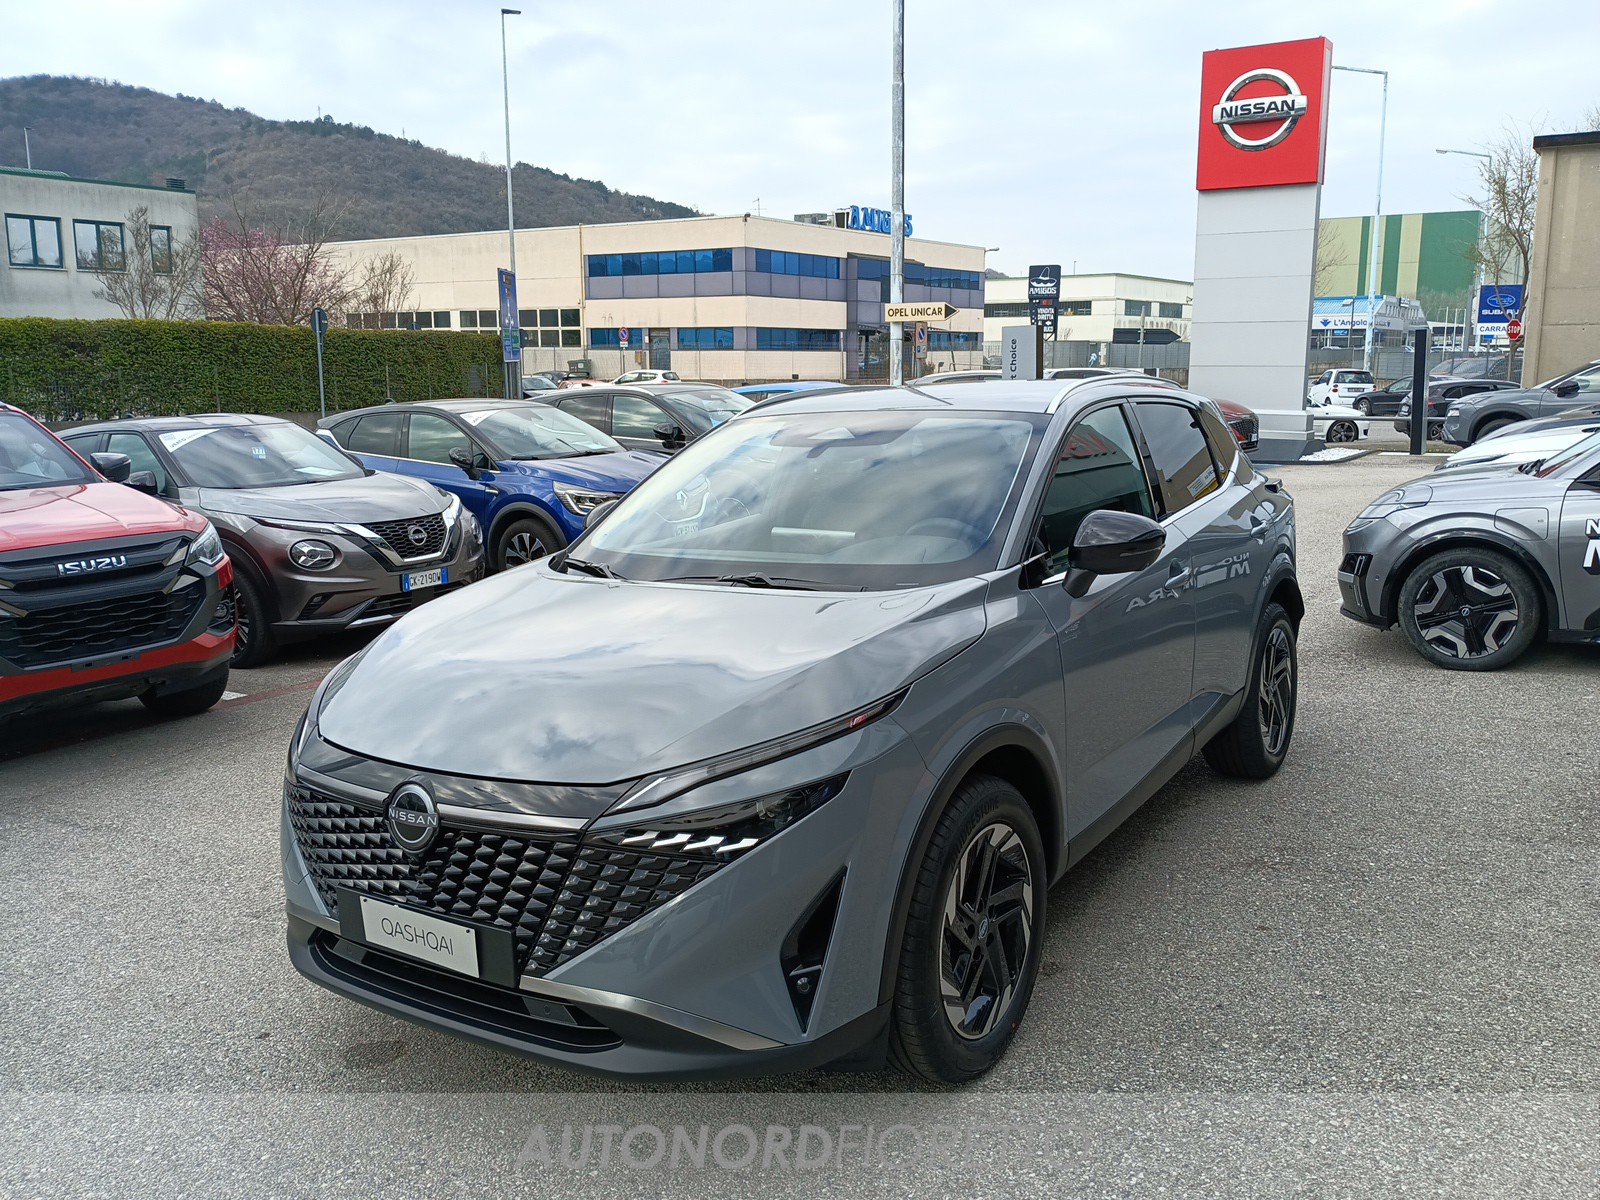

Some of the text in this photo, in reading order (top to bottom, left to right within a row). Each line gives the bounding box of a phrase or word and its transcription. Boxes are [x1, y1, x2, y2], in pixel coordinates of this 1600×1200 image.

[1220, 98, 1296, 120] NISSAN
[848, 205, 913, 237] AMIGS
[1029, 287, 1057, 295] AMIGOS
[887, 306, 943, 317] OPEL UNICAR
[1333, 319, 1368, 327] L'Angolo
[1507, 325, 1521, 334] STOP
[57, 555, 128, 576] ISUZU
[388, 808, 438, 827] NISSAN
[381, 917, 455, 956] QASHQAI
